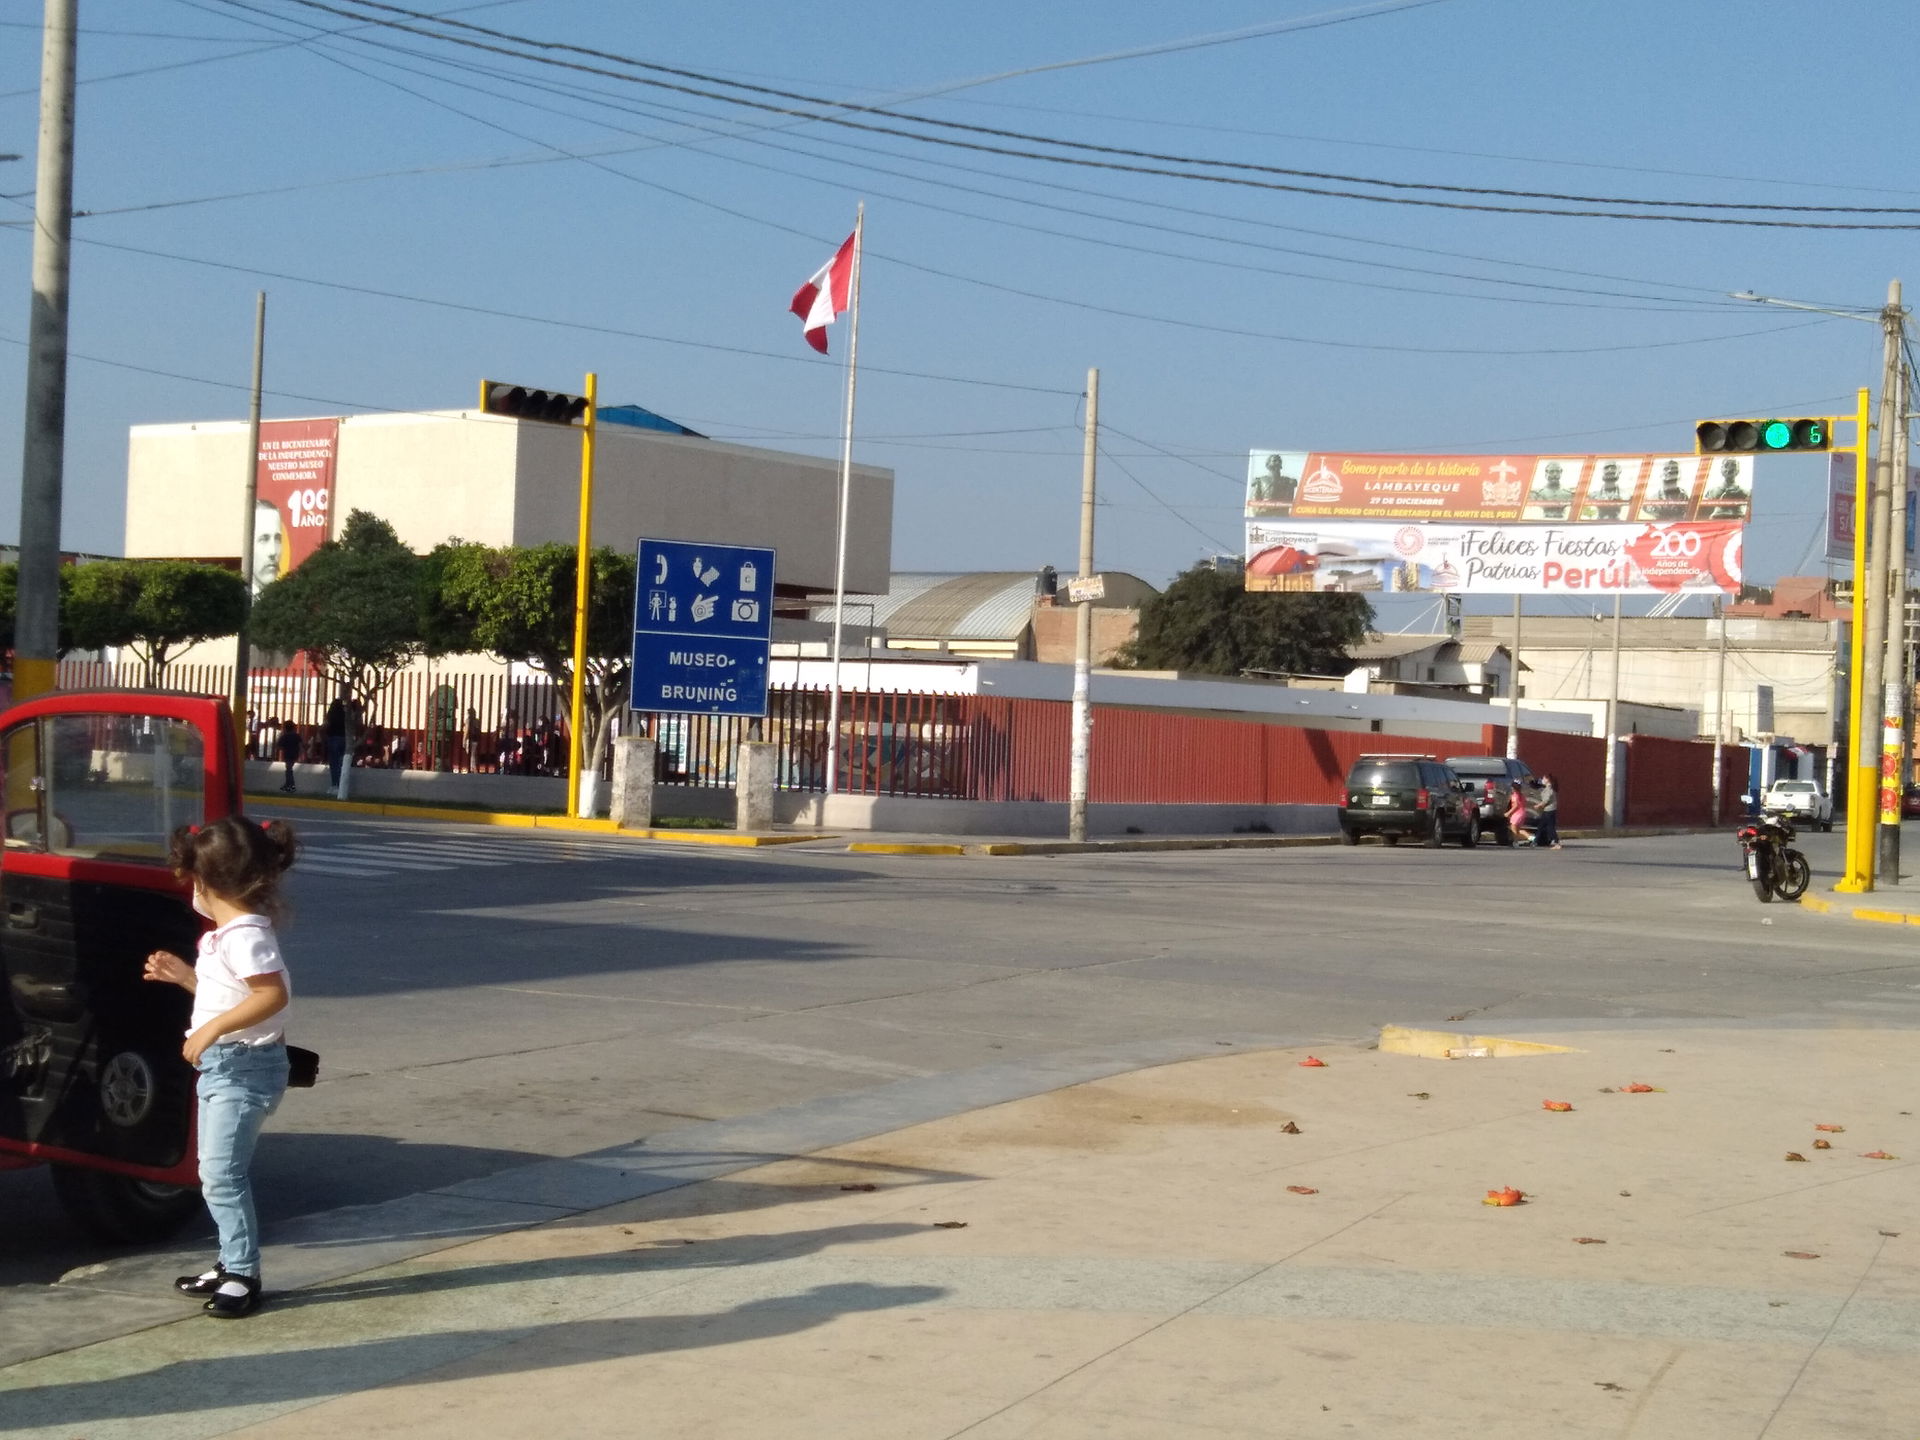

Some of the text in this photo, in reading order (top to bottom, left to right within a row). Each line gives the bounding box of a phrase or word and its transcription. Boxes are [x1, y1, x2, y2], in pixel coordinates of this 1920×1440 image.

[1810, 426, 1820, 444] 6
[263, 442, 272, 450] EN
[273, 441, 279, 449] EL
[268, 452, 277, 460] LA
[268, 460, 324, 470] NUESTRO MUSEO
[1341, 459, 1480, 480] Somos parte de la historia
[272, 472, 317, 481] CONMEMORA
[1364, 482, 1461, 493] LAMBAYEQUE
[1387, 509, 1430, 517] LIBERTARIO
[1453, 510, 1479, 518] NORTE
[1265, 535, 1318, 544] Lambayeque
[1544, 530, 1621, 557] Fiestas
[1649, 531, 1702, 557] 200
[1656, 560, 1689, 568] Años de
[1465, 556, 1630, 589] Patrias Perú!
[669, 652, 728, 668] MUSEO
[661, 685, 738, 702] BRUNING
